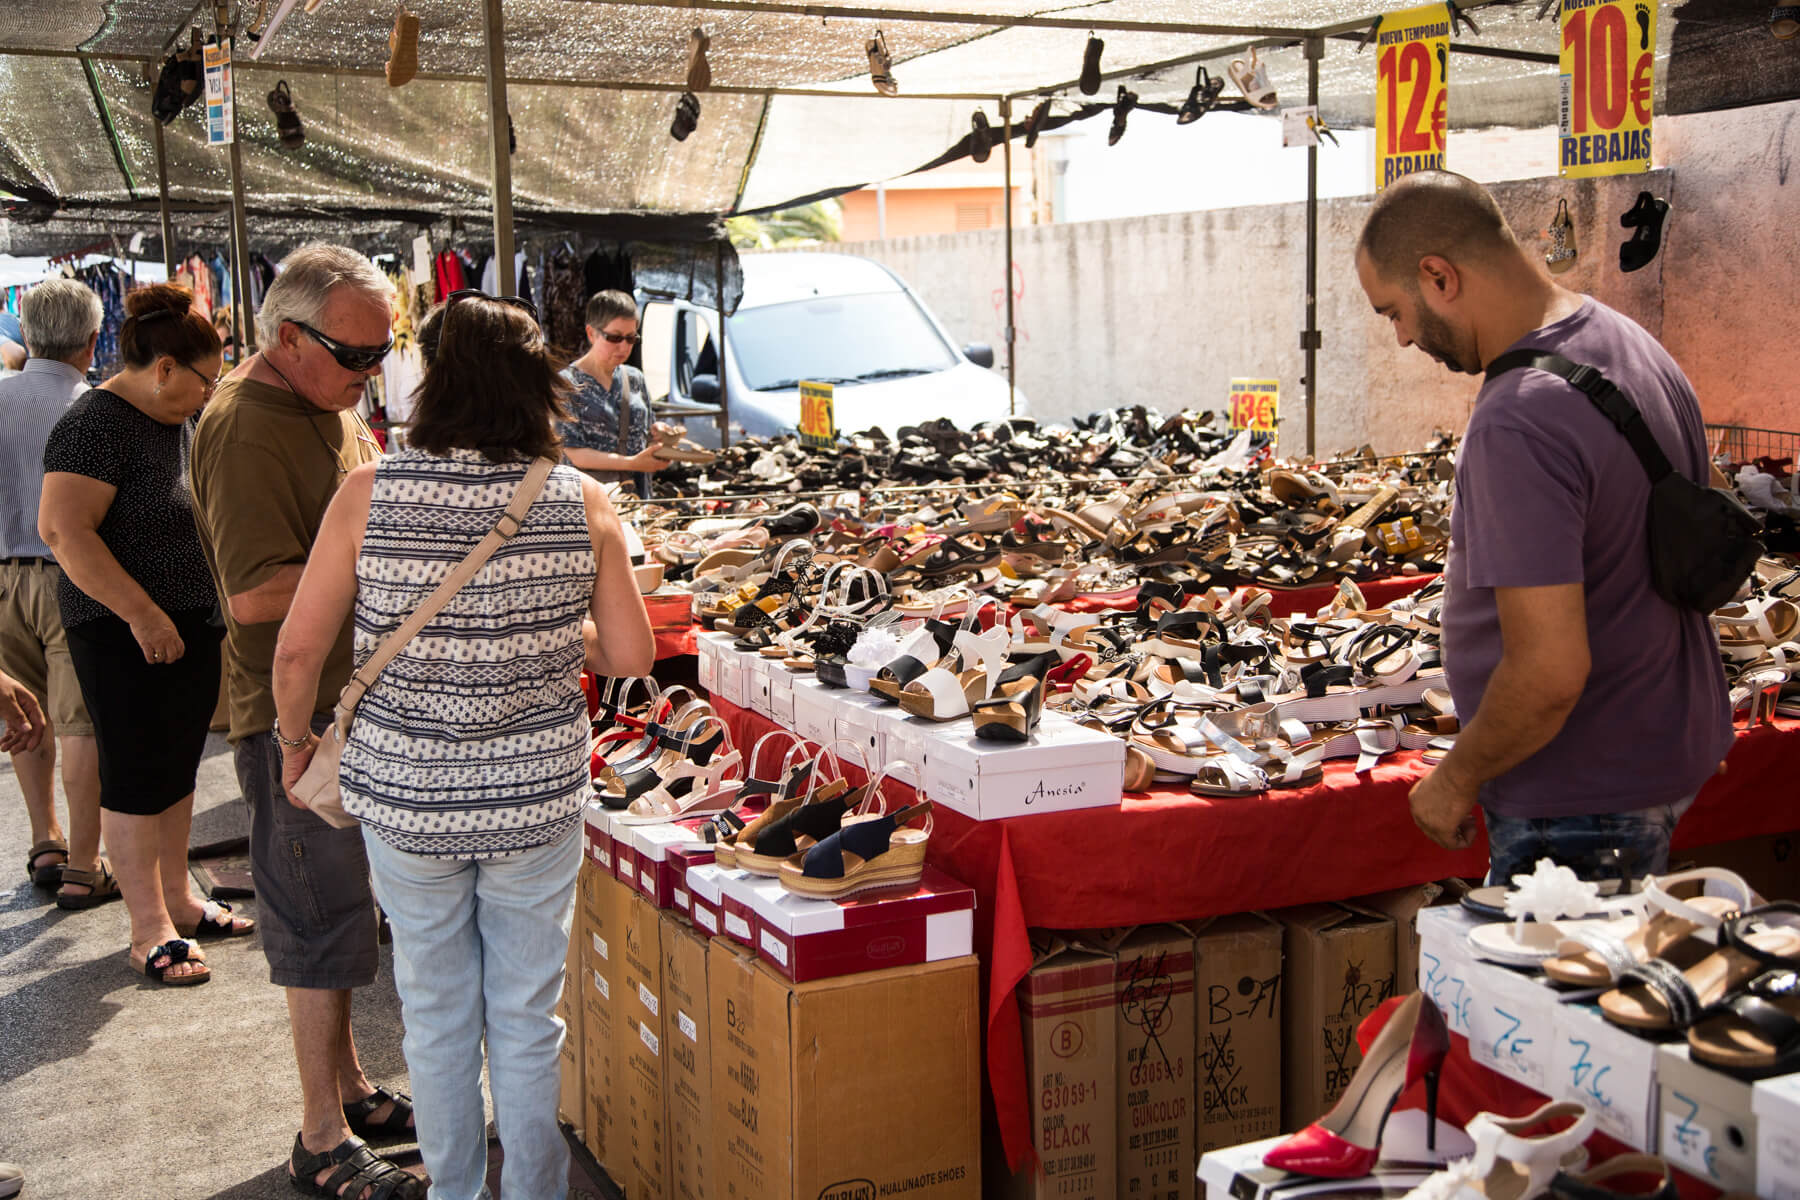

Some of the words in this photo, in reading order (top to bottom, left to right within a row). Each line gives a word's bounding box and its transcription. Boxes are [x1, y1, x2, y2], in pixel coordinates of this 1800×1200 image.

[1380, 30, 1403, 46] NUEVA
[1563, 4, 1653, 134] 10€
[1379, 41, 1448, 154] 12€
[1562, 128, 1651, 167] REBAJAS
[1230, 393, 1270, 428] 13€
[1041, 1079, 1097, 1111] G3059-1
[1132, 1097, 1186, 1128] GUNCOLOR
[1043, 1122, 1091, 1152] BLACK
[879, 1172, 936, 1197] HUALUNAOTE
[937, 1165, 966, 1184] SHOES
